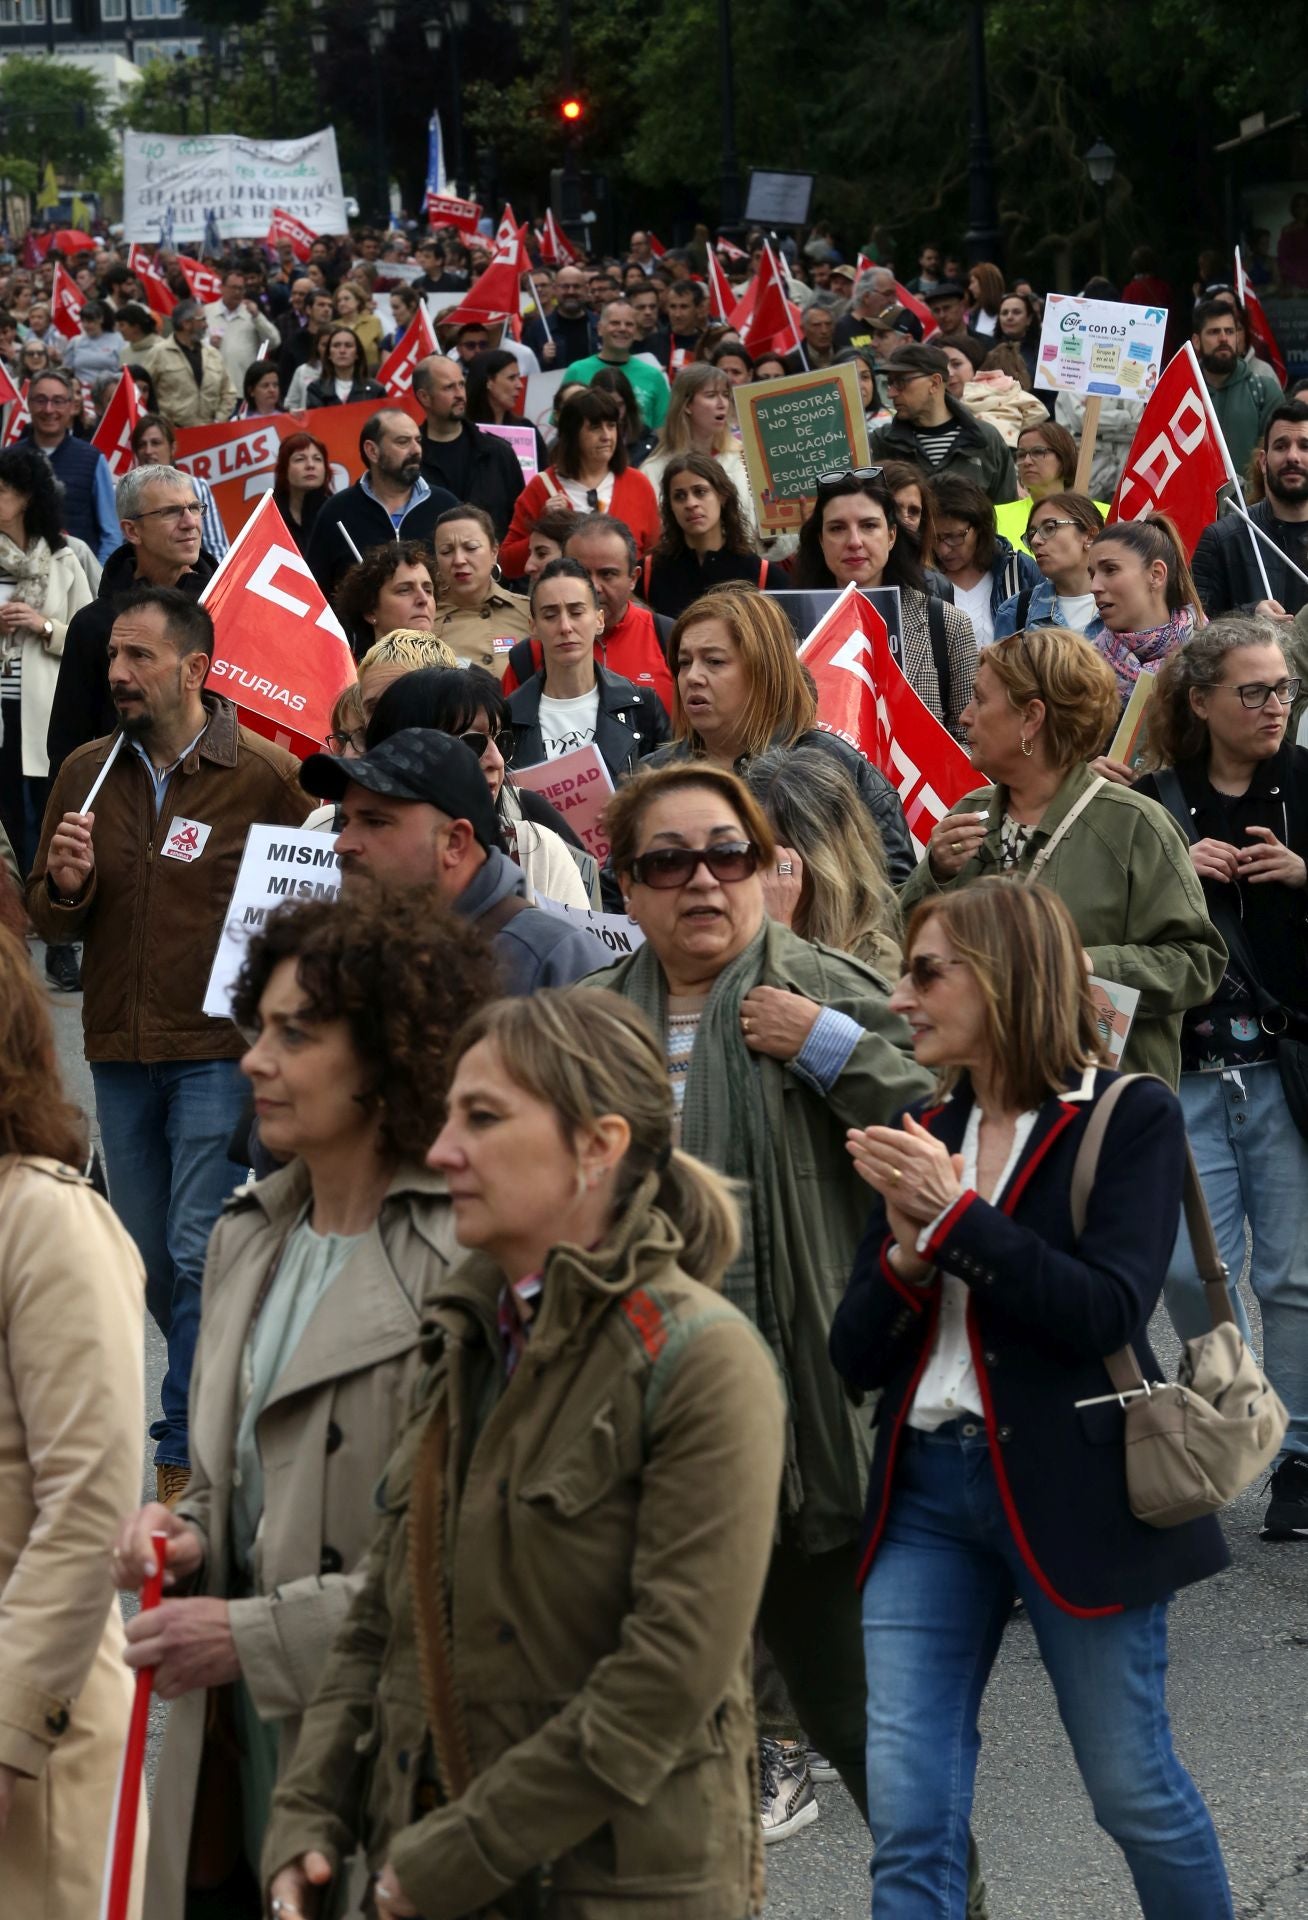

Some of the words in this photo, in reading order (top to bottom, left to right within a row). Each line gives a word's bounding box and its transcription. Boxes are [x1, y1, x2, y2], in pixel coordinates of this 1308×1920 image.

[1088, 324, 1108, 334] con
[1110, 325, 1127, 337] 0-3
[757, 409, 769, 420] SI
[773, 390, 841, 416] NOSOTRAS
[768, 418, 787, 430] NO
[792, 405, 836, 425] SOMOS
[769, 430, 846, 457] EDUCACIÓN,
[796, 425, 815, 437] DE
[218, 434, 270, 475] LAS
[211, 659, 307, 712] STURIAS
[540, 767, 600, 800] RIEDAD
[554, 791, 588, 814] RAL
[585, 924, 633, 953] IÓN
